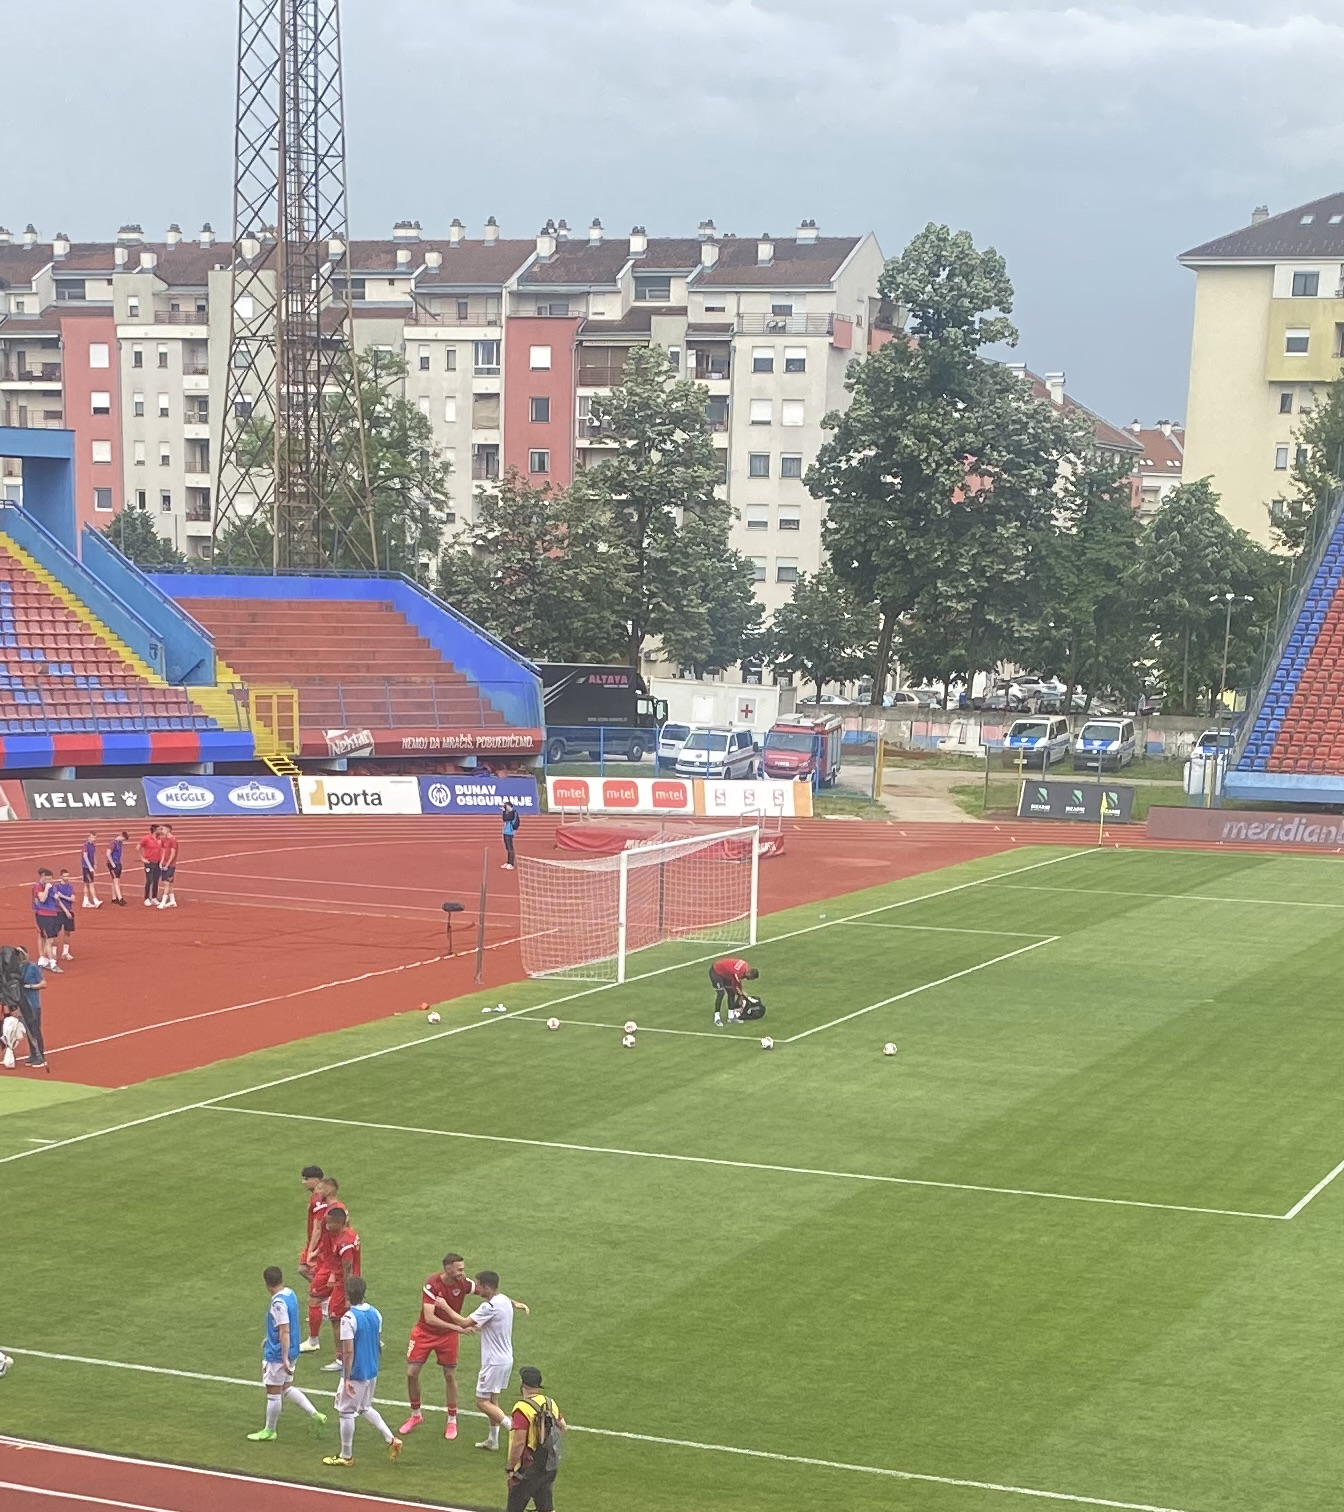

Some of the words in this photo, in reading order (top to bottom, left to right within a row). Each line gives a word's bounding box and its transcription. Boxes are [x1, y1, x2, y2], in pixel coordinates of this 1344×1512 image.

[588, 674, 628, 684] ALTAYA
[331, 730, 370, 755] Nektar
[429, 736, 440, 749] DA
[455, 784, 496, 795] DUNAV
[33, 792, 117, 808] KELME
[165, 792, 206, 802] MEGGLE
[236, 791, 277, 802] MEGGLE
[327, 789, 384, 810] porta
[456, 795, 533, 807] OSIGURANJE
